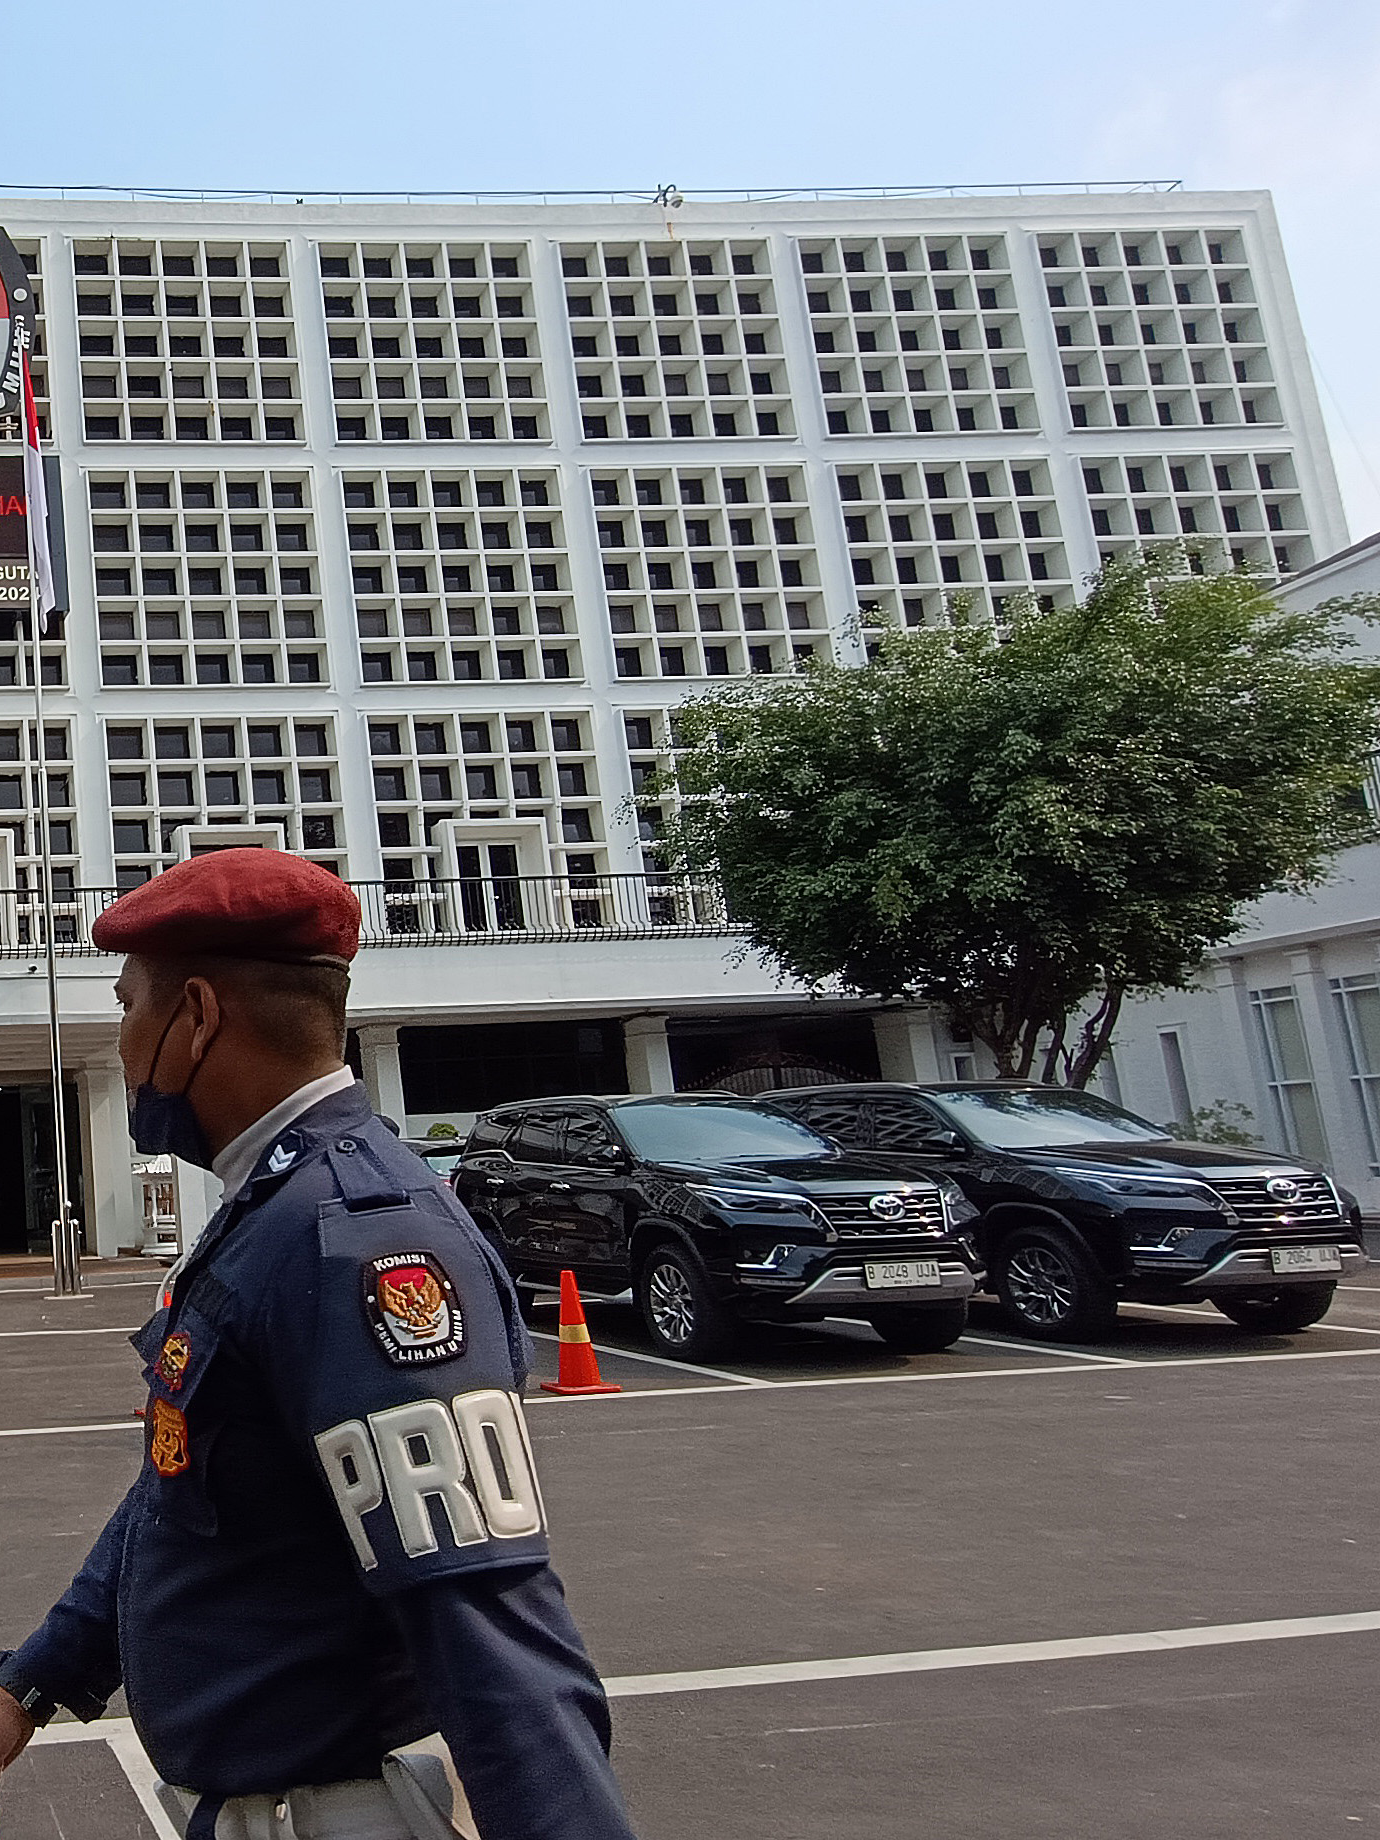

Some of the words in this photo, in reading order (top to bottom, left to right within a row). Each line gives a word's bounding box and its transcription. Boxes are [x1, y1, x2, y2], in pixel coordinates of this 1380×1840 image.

[373, 1254, 426, 1272] KOMISI
[867, 1265, 875, 1280] B
[882, 1264, 909, 1279] 2048
[314, 1389, 549, 1572] PRO
